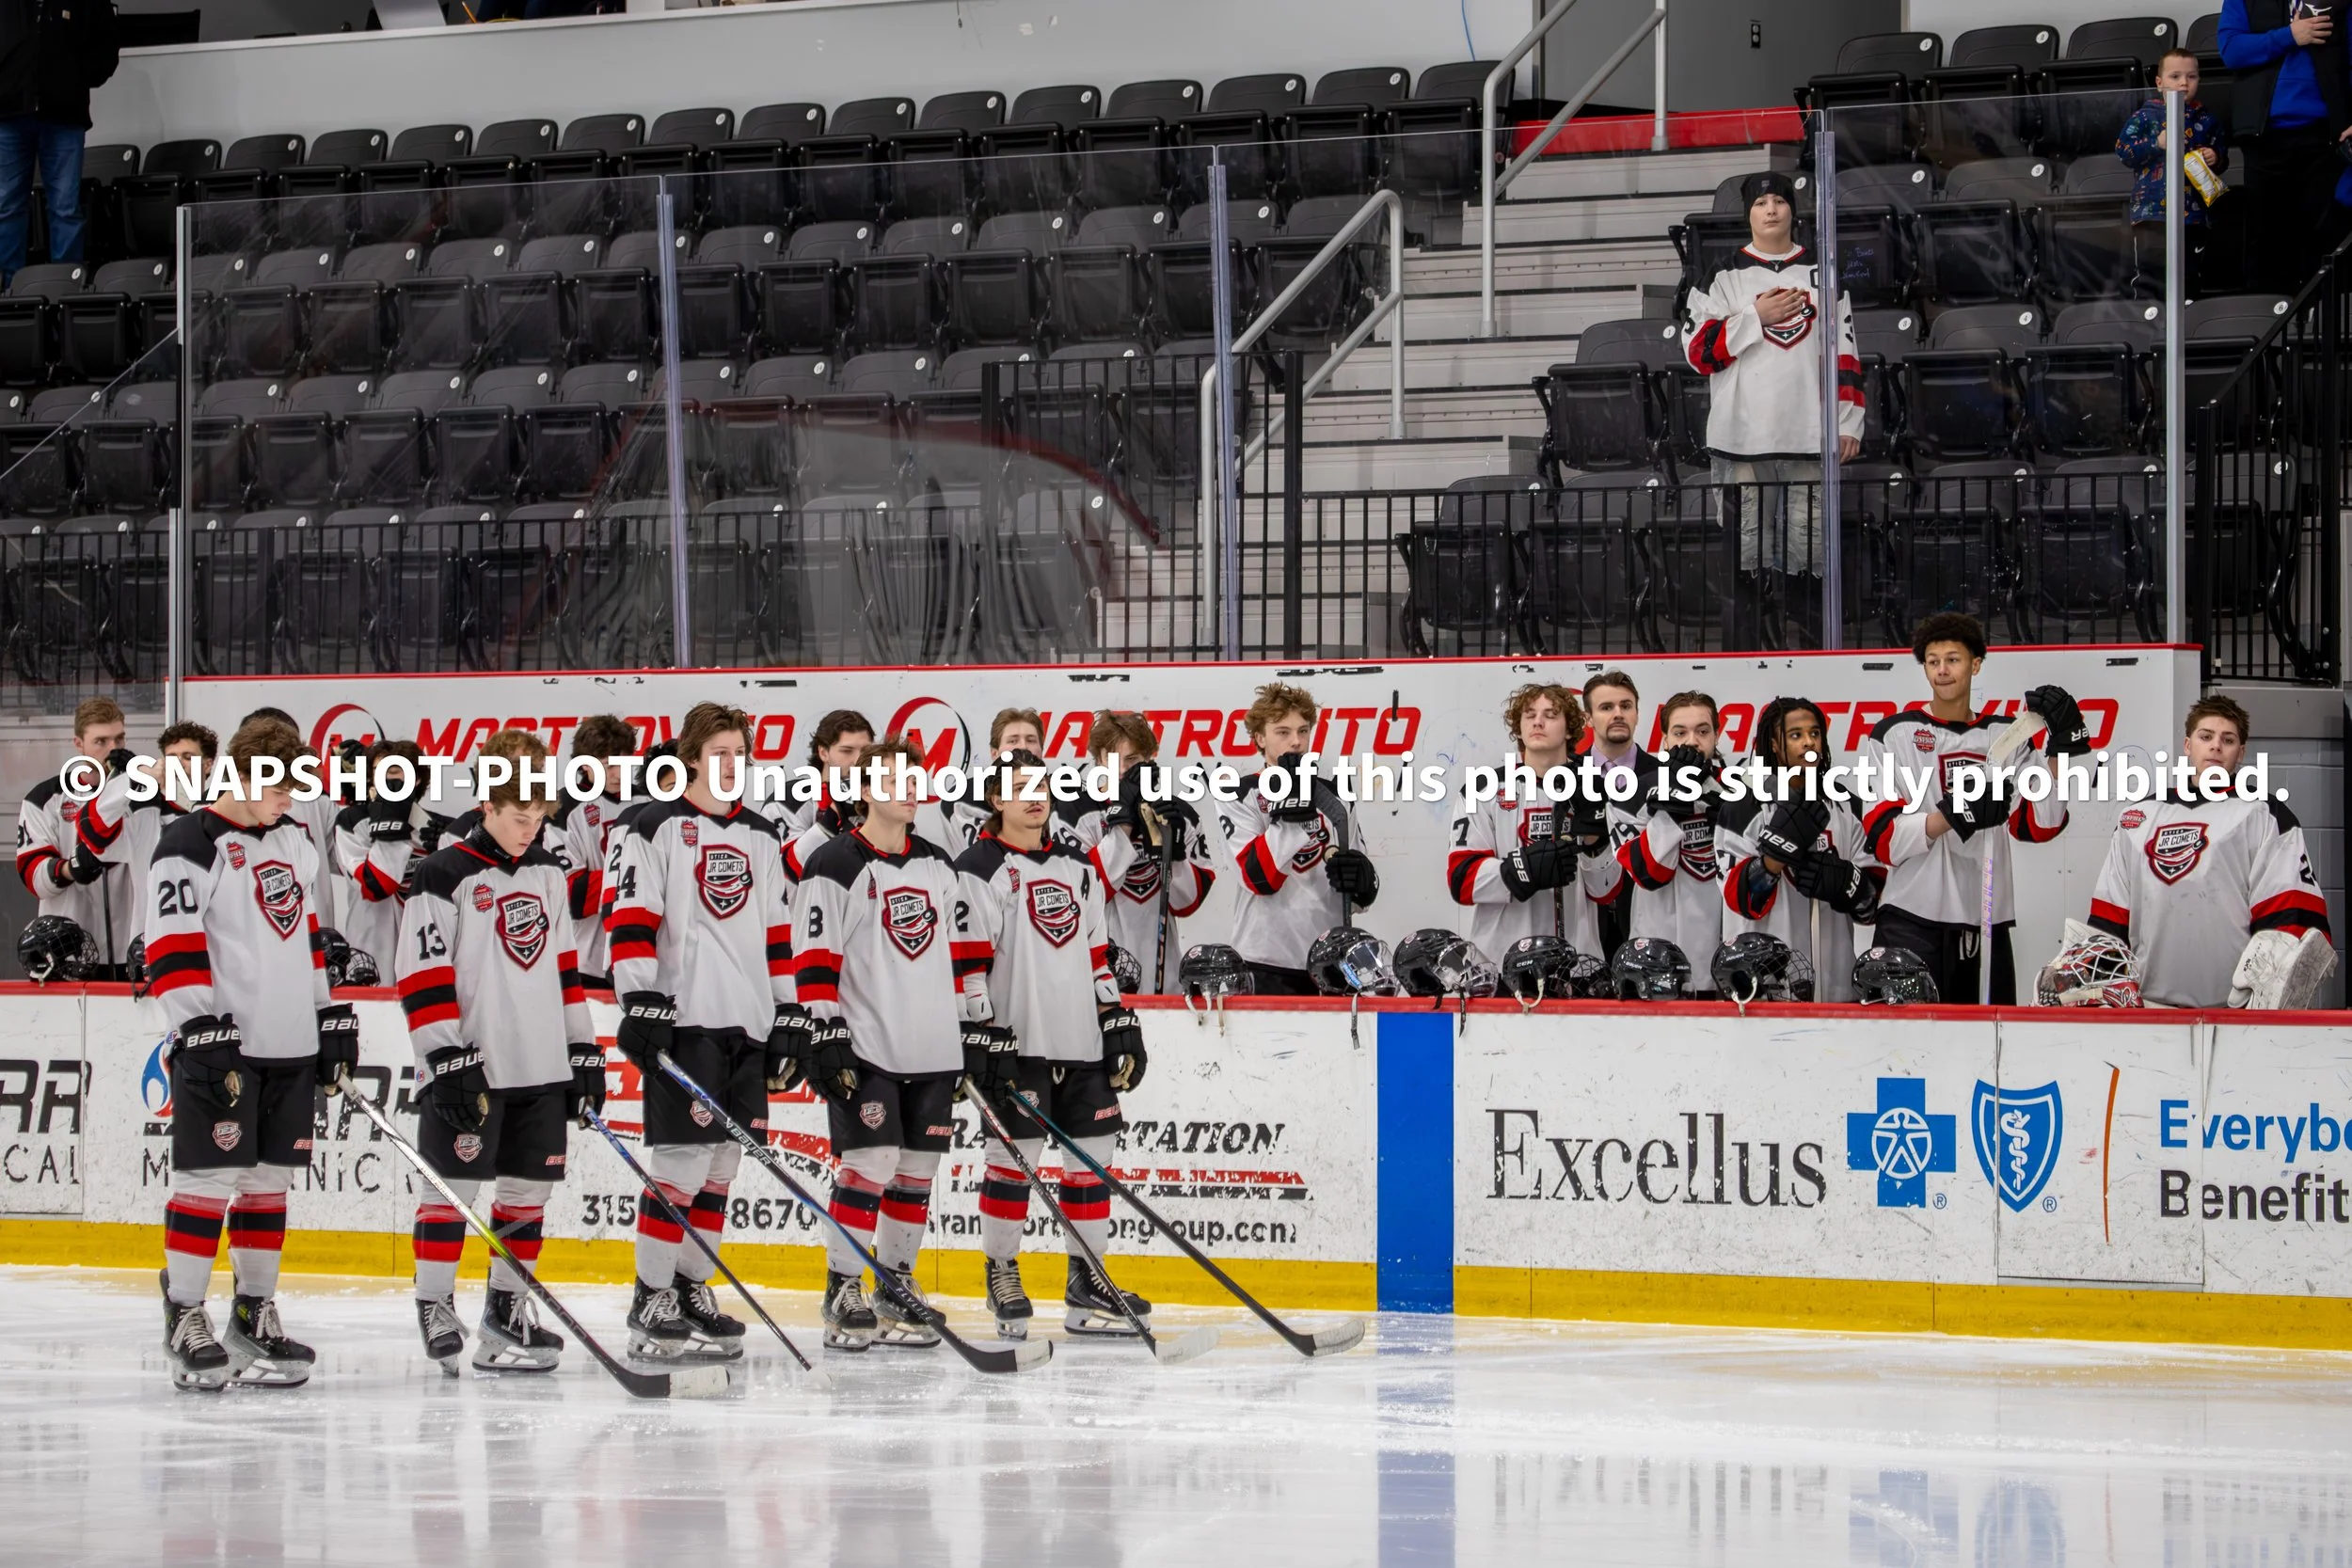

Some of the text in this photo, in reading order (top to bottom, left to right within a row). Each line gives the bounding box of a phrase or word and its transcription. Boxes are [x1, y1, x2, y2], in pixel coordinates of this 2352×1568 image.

[2170, 832, 2199, 847] COMETS
[707, 861, 744, 873] JR COMETS
[271, 874, 292, 892] COMETS
[158, 878, 199, 919] 20
[900, 899, 924, 916] COMETS
[1046, 893, 1070, 906] COMETS
[516, 905, 539, 924] COMETS
[417, 922, 447, 961] 13
[2160, 1099, 2352, 1164] Everyb
[730, 1126, 772, 1166] BAUER
[1485, 1108, 1829, 1210] Excellus
[895, 1286, 934, 1323] FLYLITE
